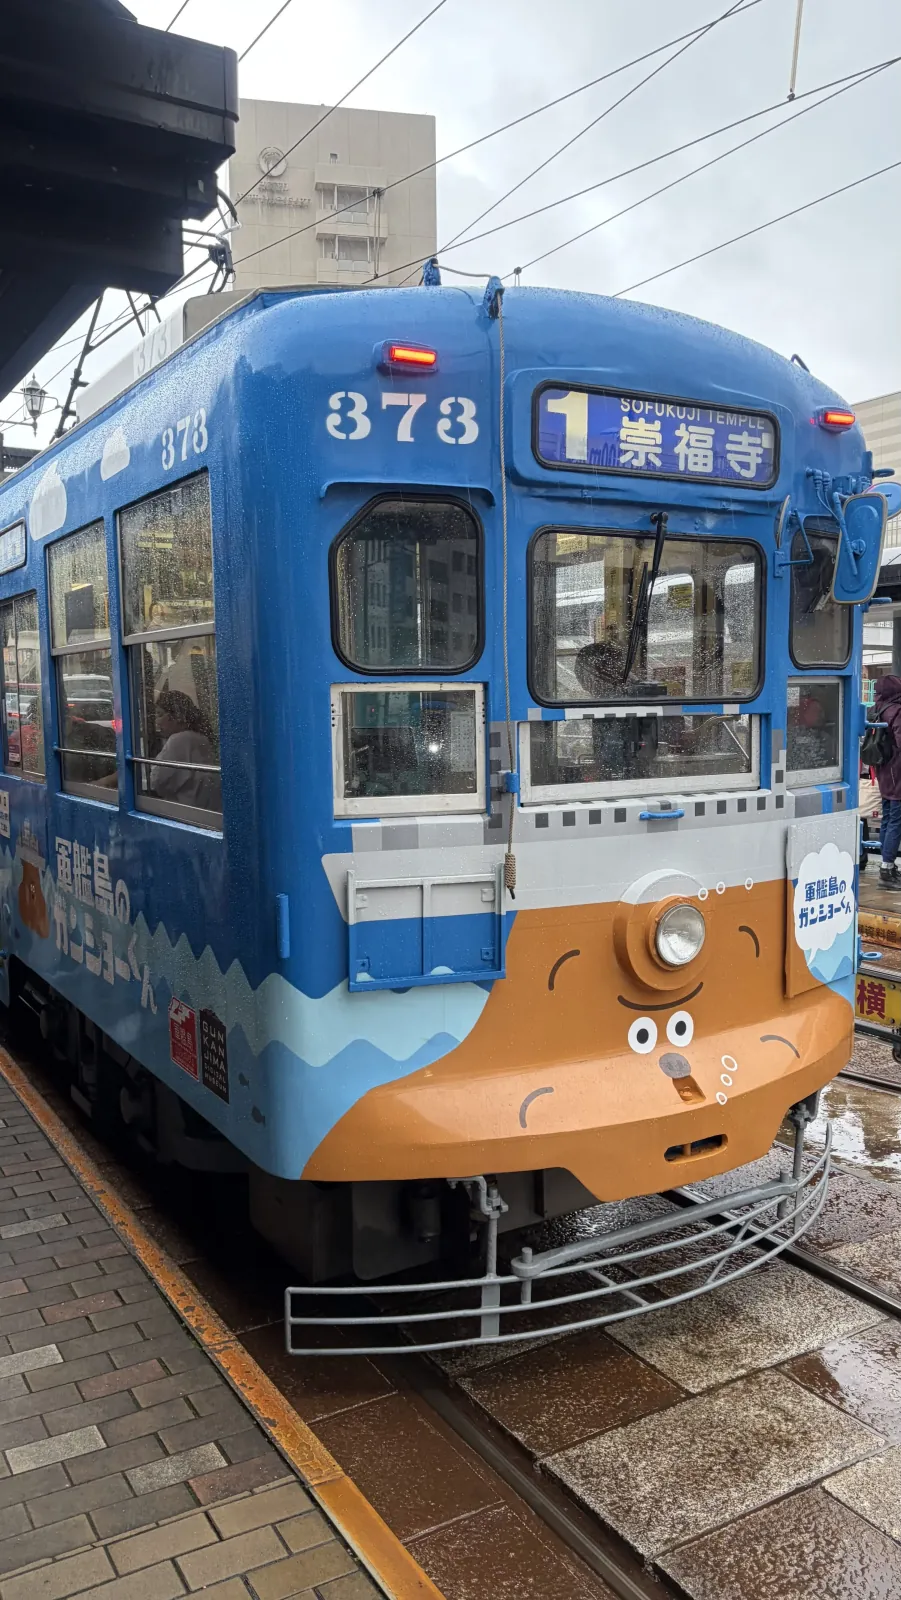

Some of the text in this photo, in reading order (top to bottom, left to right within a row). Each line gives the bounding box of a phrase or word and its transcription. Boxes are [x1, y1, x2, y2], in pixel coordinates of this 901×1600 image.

[325, 390, 480, 445] 373
[547, 391, 589, 461] 1
[620, 397, 765, 430] SOFUKUJI TEMPLE
[161, 407, 209, 471] 373
[619, 415, 764, 478] 崇福寺
[55, 836, 131, 925] 軍艦島の
[804, 875, 848, 902] 軍艦島の
[798, 895, 852, 929] ガンショーくん
[857, 978, 887, 1020] 横
[202, 1020, 224, 1043] GUN
[203, 1034, 225, 1059] KAN
[203, 1051, 226, 1073] JIMA
